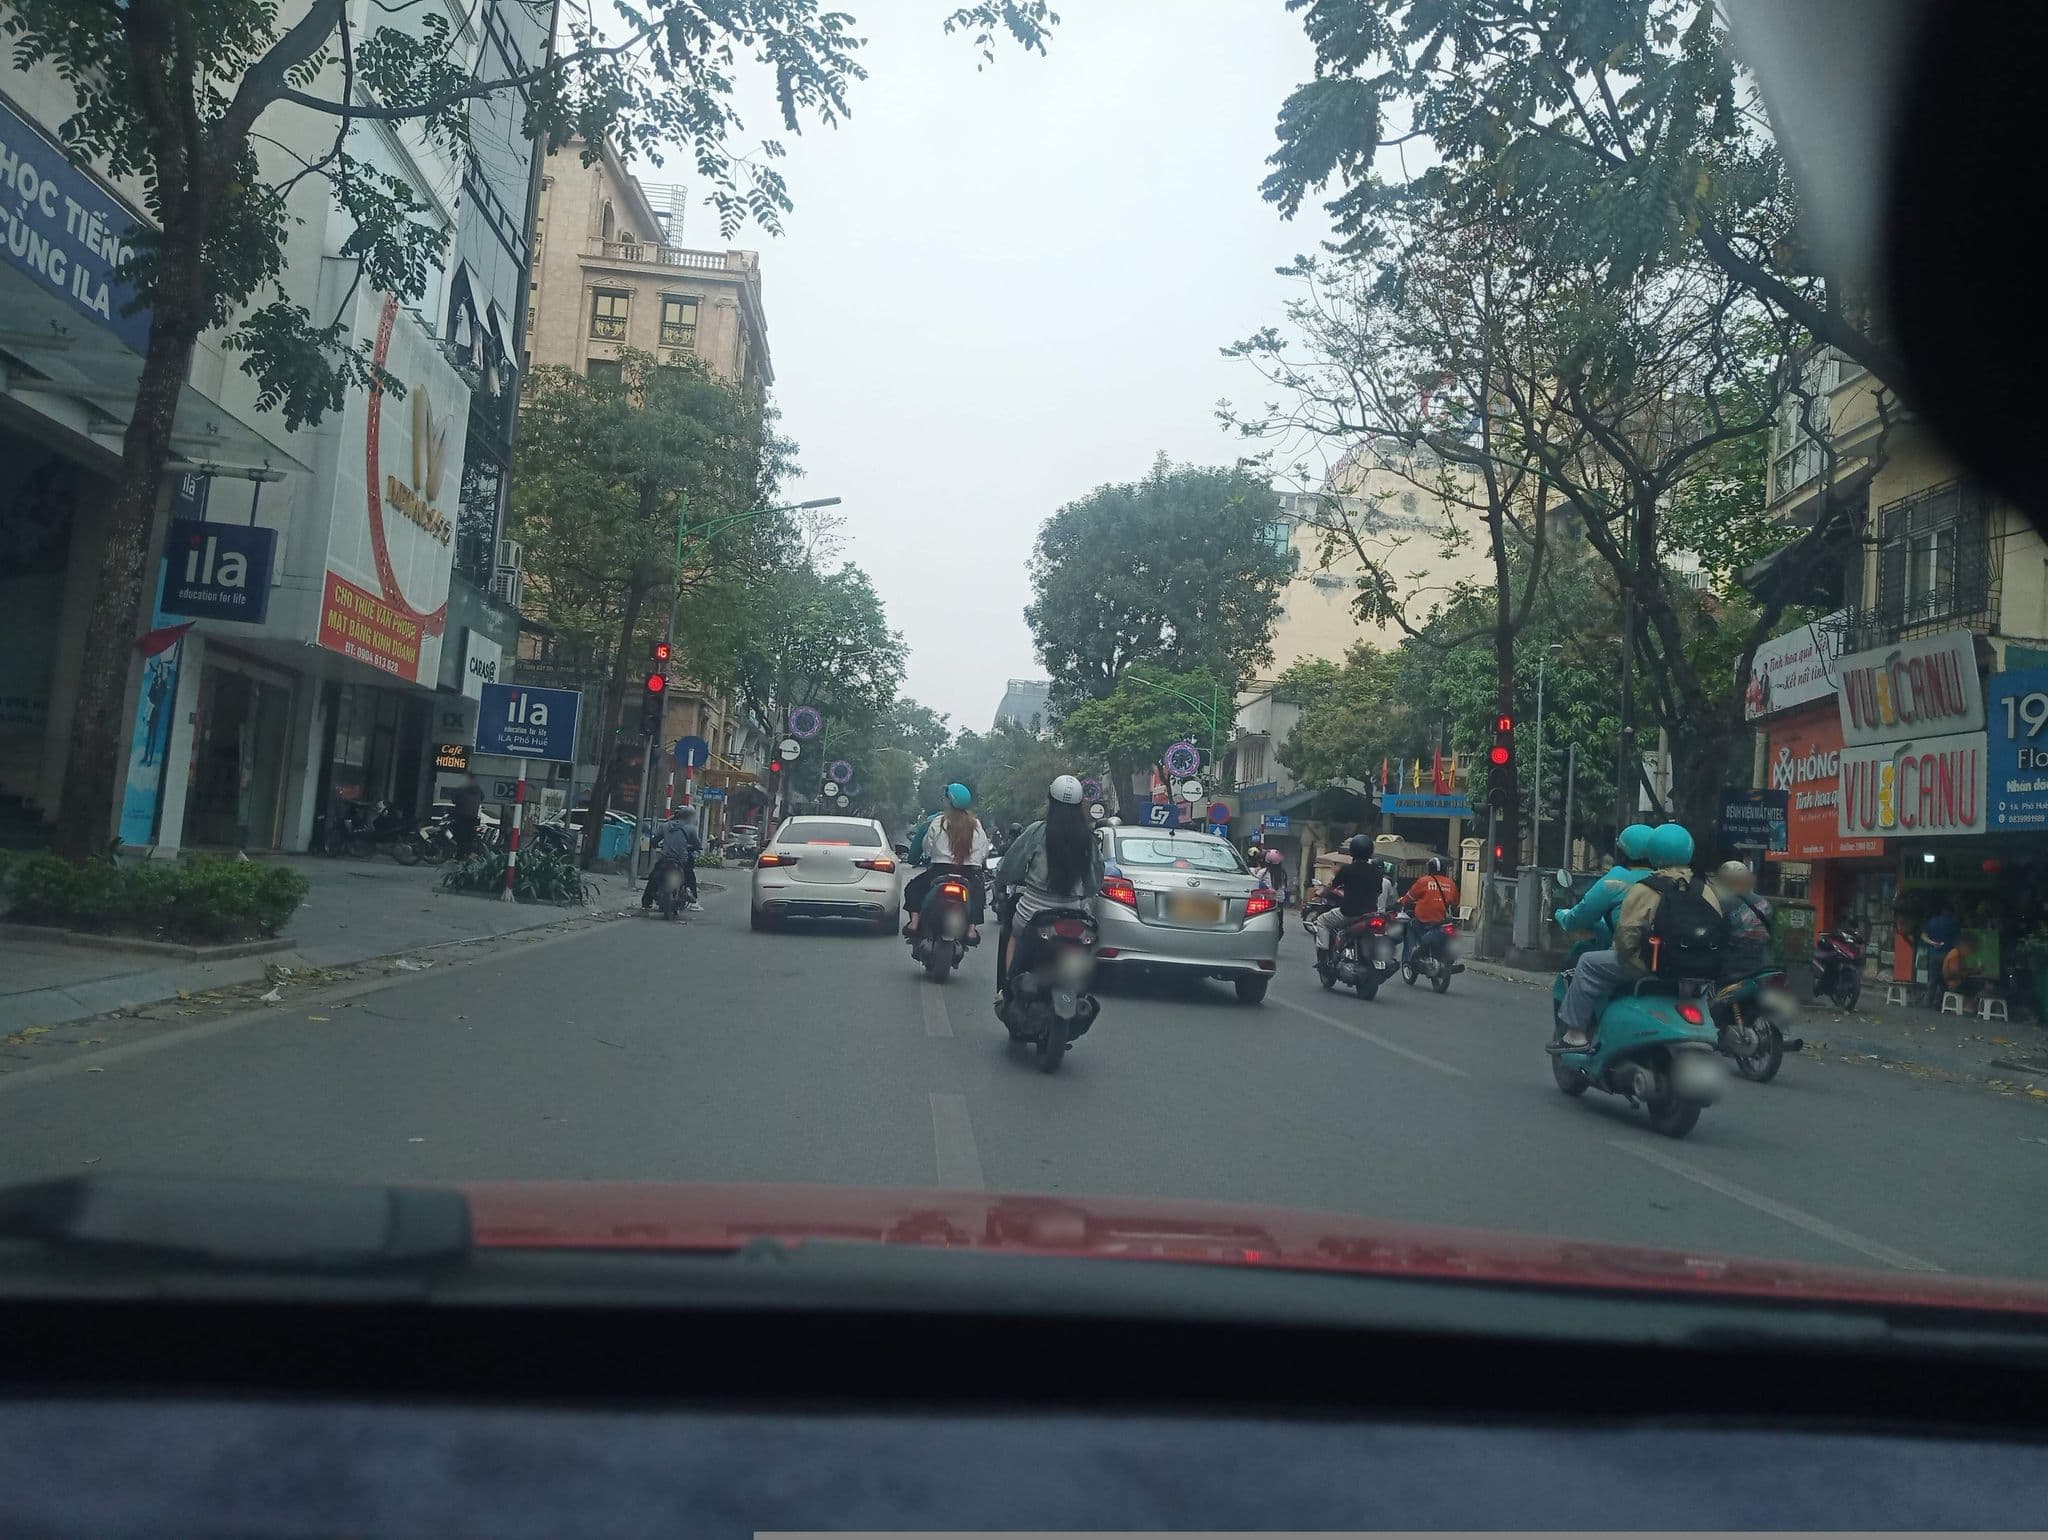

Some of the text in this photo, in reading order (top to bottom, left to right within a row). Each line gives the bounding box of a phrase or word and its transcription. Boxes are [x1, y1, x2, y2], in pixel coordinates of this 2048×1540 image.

[72, 264, 110, 320] ILA
[186, 535, 248, 588] ila
[178, 589, 247, 605] education for life
[335, 585, 353, 608] CHO
[372, 630, 391, 653] KINH
[508, 691, 548, 726] ila
[498, 734, 512, 742] ILA
[1798, 744, 1838, 782] HỒNG
[1151, 806, 1169, 824] G7
